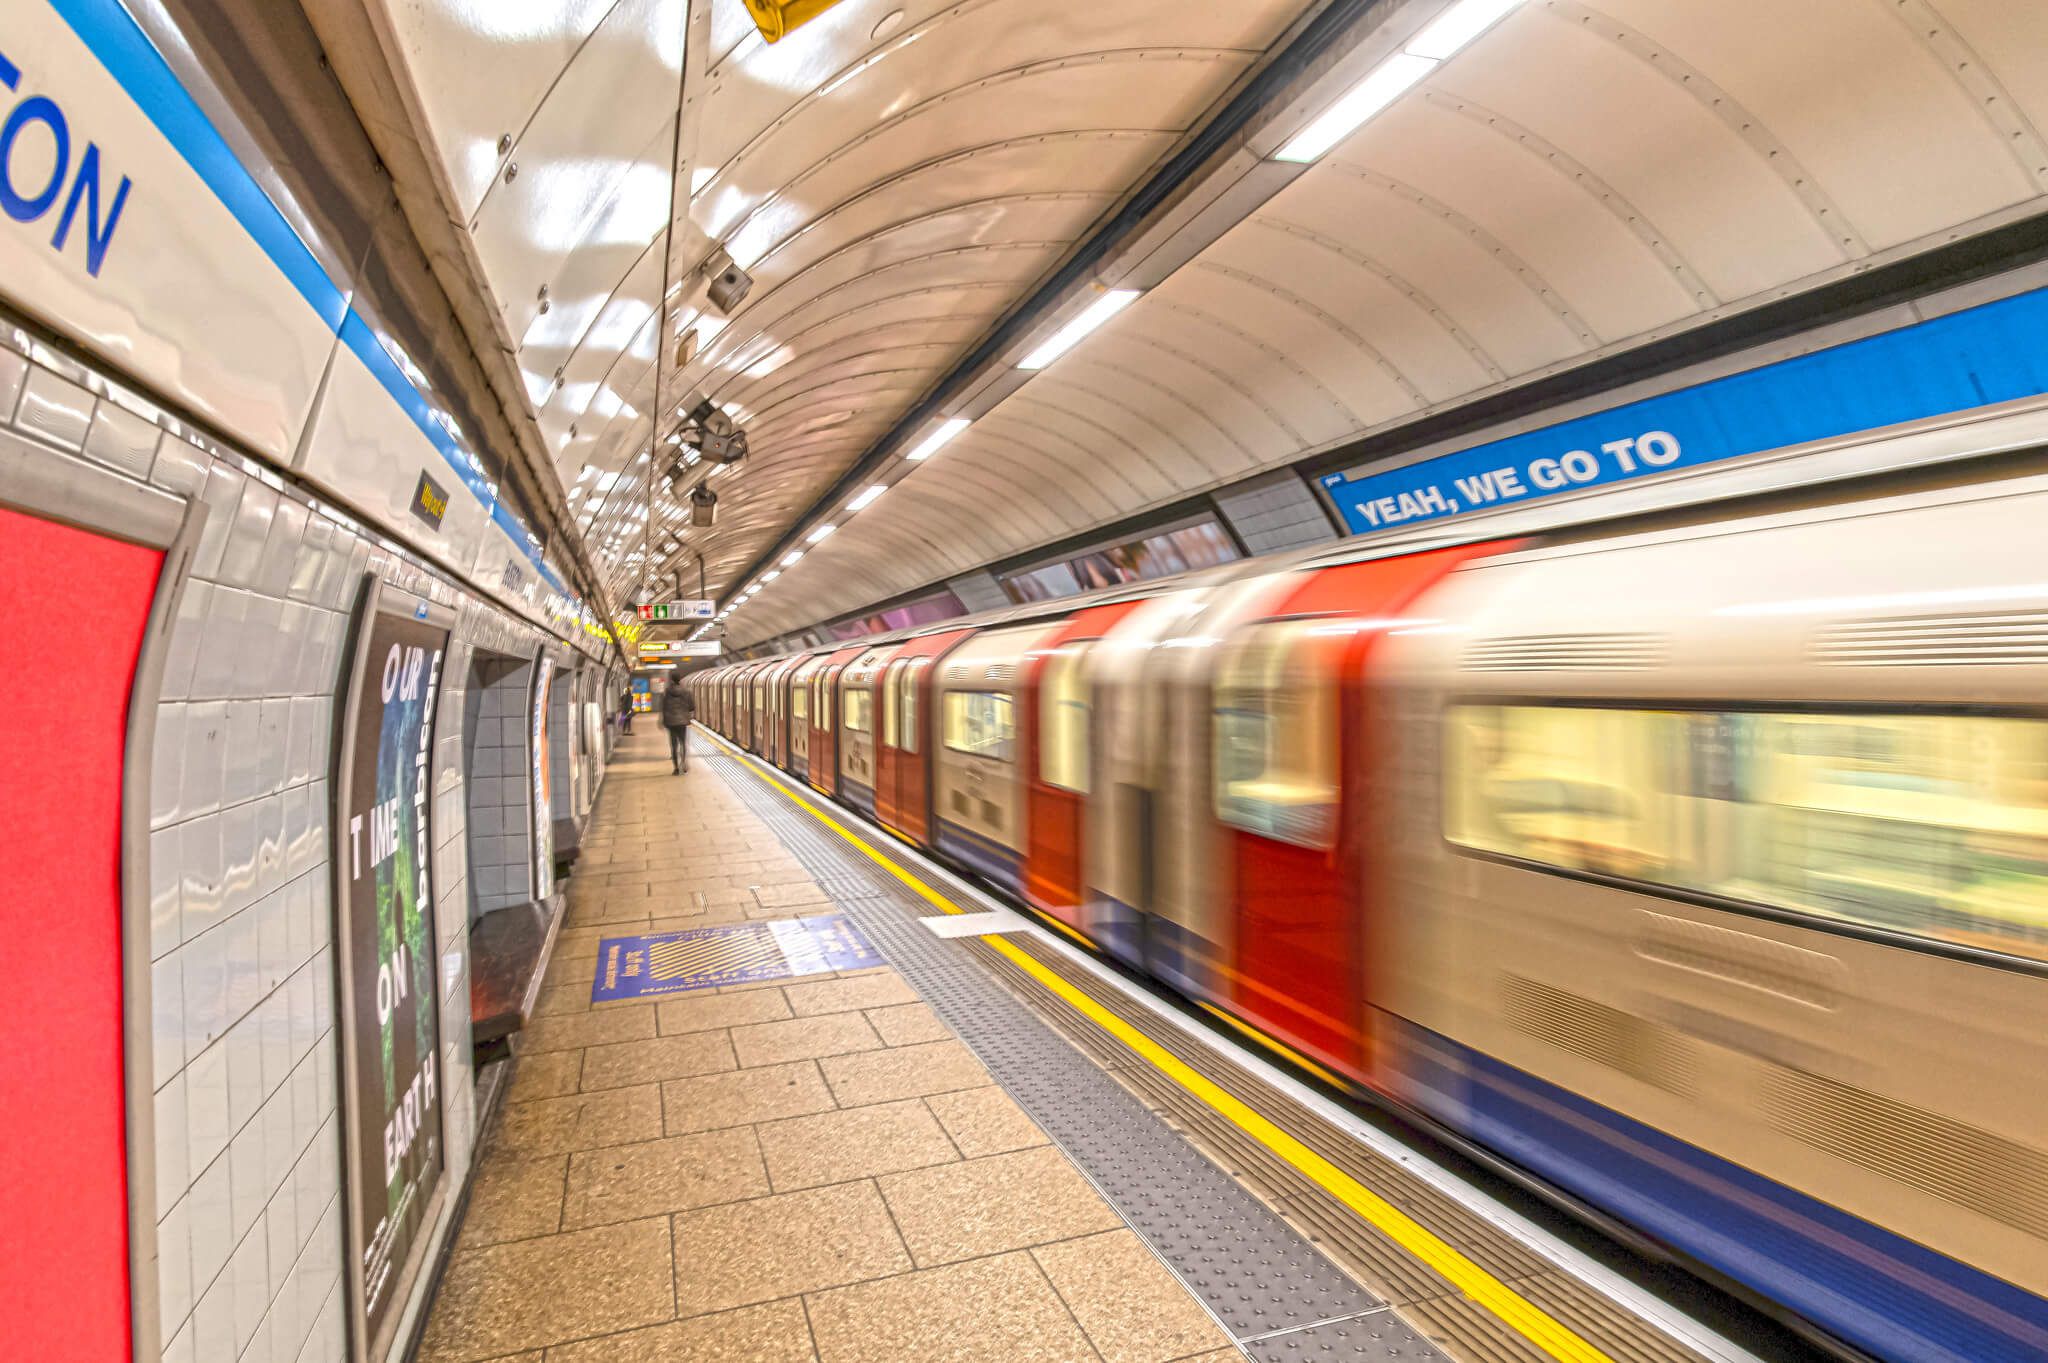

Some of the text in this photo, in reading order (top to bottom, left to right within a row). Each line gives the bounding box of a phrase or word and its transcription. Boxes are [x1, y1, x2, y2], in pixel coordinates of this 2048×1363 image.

[0, 53, 133, 279] ON
[1355, 430, 1682, 527] YEAH, WE GO TO
[381, 642, 424, 704] OUR
[415, 649, 443, 913] barbican
[350, 798, 399, 881] TIME
[377, 942, 408, 1026] ON
[384, 1049, 435, 1188] EARTH
